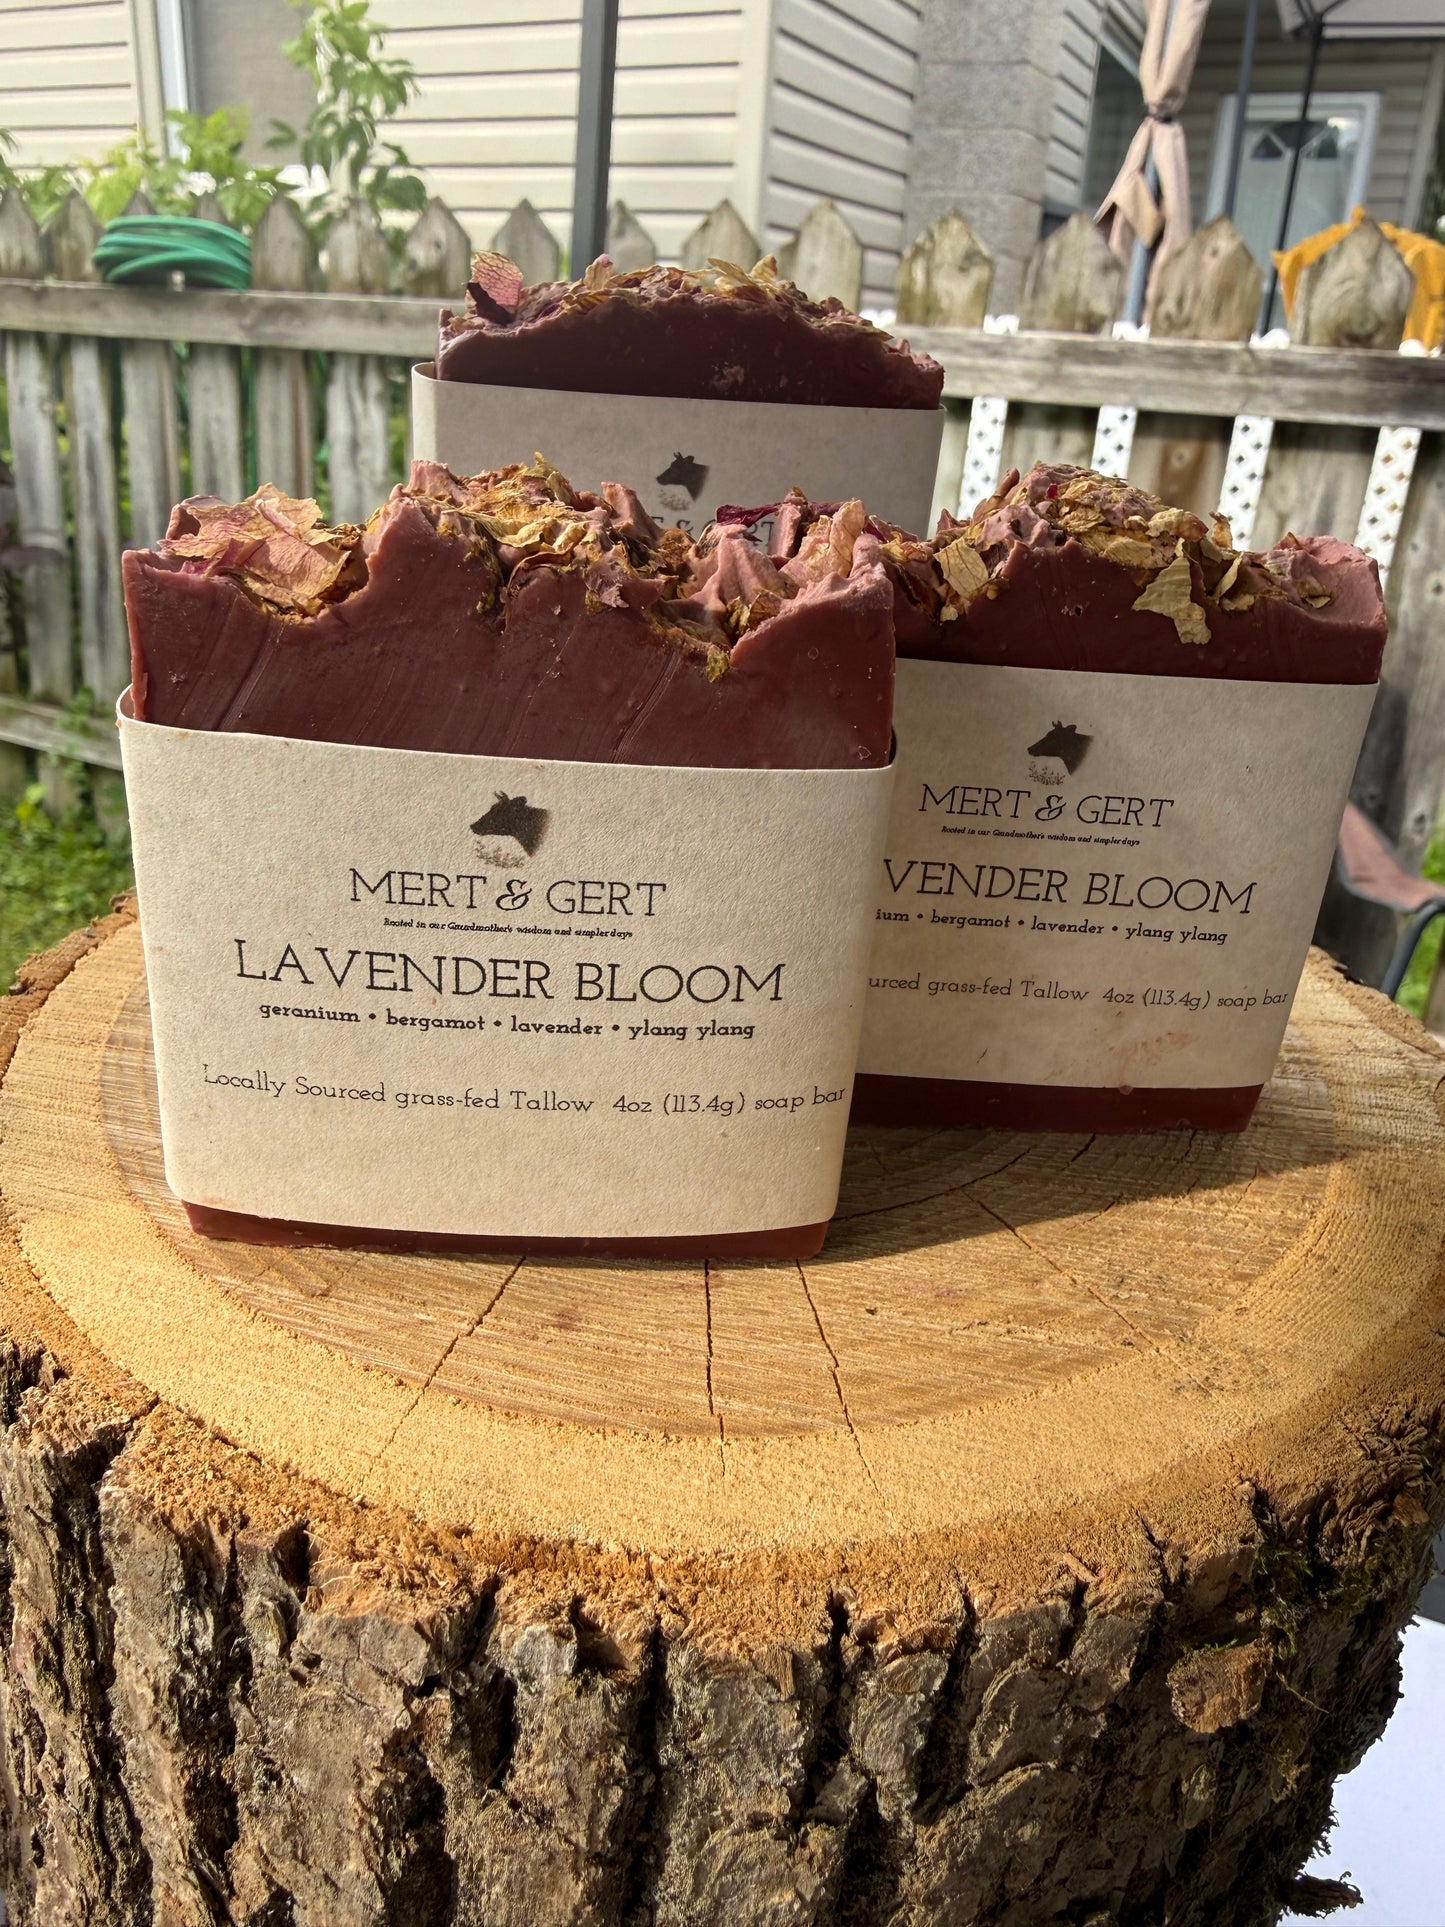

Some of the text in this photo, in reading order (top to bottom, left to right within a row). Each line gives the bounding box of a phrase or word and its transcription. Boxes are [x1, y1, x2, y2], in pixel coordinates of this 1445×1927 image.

[918, 784, 1174, 827] MERT & GERT
[941, 826, 966, 835] Rooted
[1048, 832, 1076, 842] wisdom
[1077, 834, 1092, 843] and
[350, 868, 666, 917] MERT & GERT
[883, 859, 1257, 914] VENDER BLOOM
[383, 917, 414, 928] Rooted
[416, 920, 426, 929] in
[429, 922, 446, 930] our
[516, 925, 552, 936] wisdom
[554, 926, 572, 936] and
[930, 909, 1010, 929] bergamot
[1031, 915, 1105, 935] lavender
[1125, 922, 1174, 942] ylang
[1179, 926, 1228, 945] ylang
[234, 938, 786, 1003] LAVENDER BLOOM
[868, 973, 1288, 1011] urced grass-fed Tallow 4oz (113.4g) soap bar
[259, 1004, 755, 1040] geranium bergamot lavender ylang ylang
[203, 1063, 847, 1117] Locally Sourced grass-fed Tallow 4oz (113.4g) soap bar
